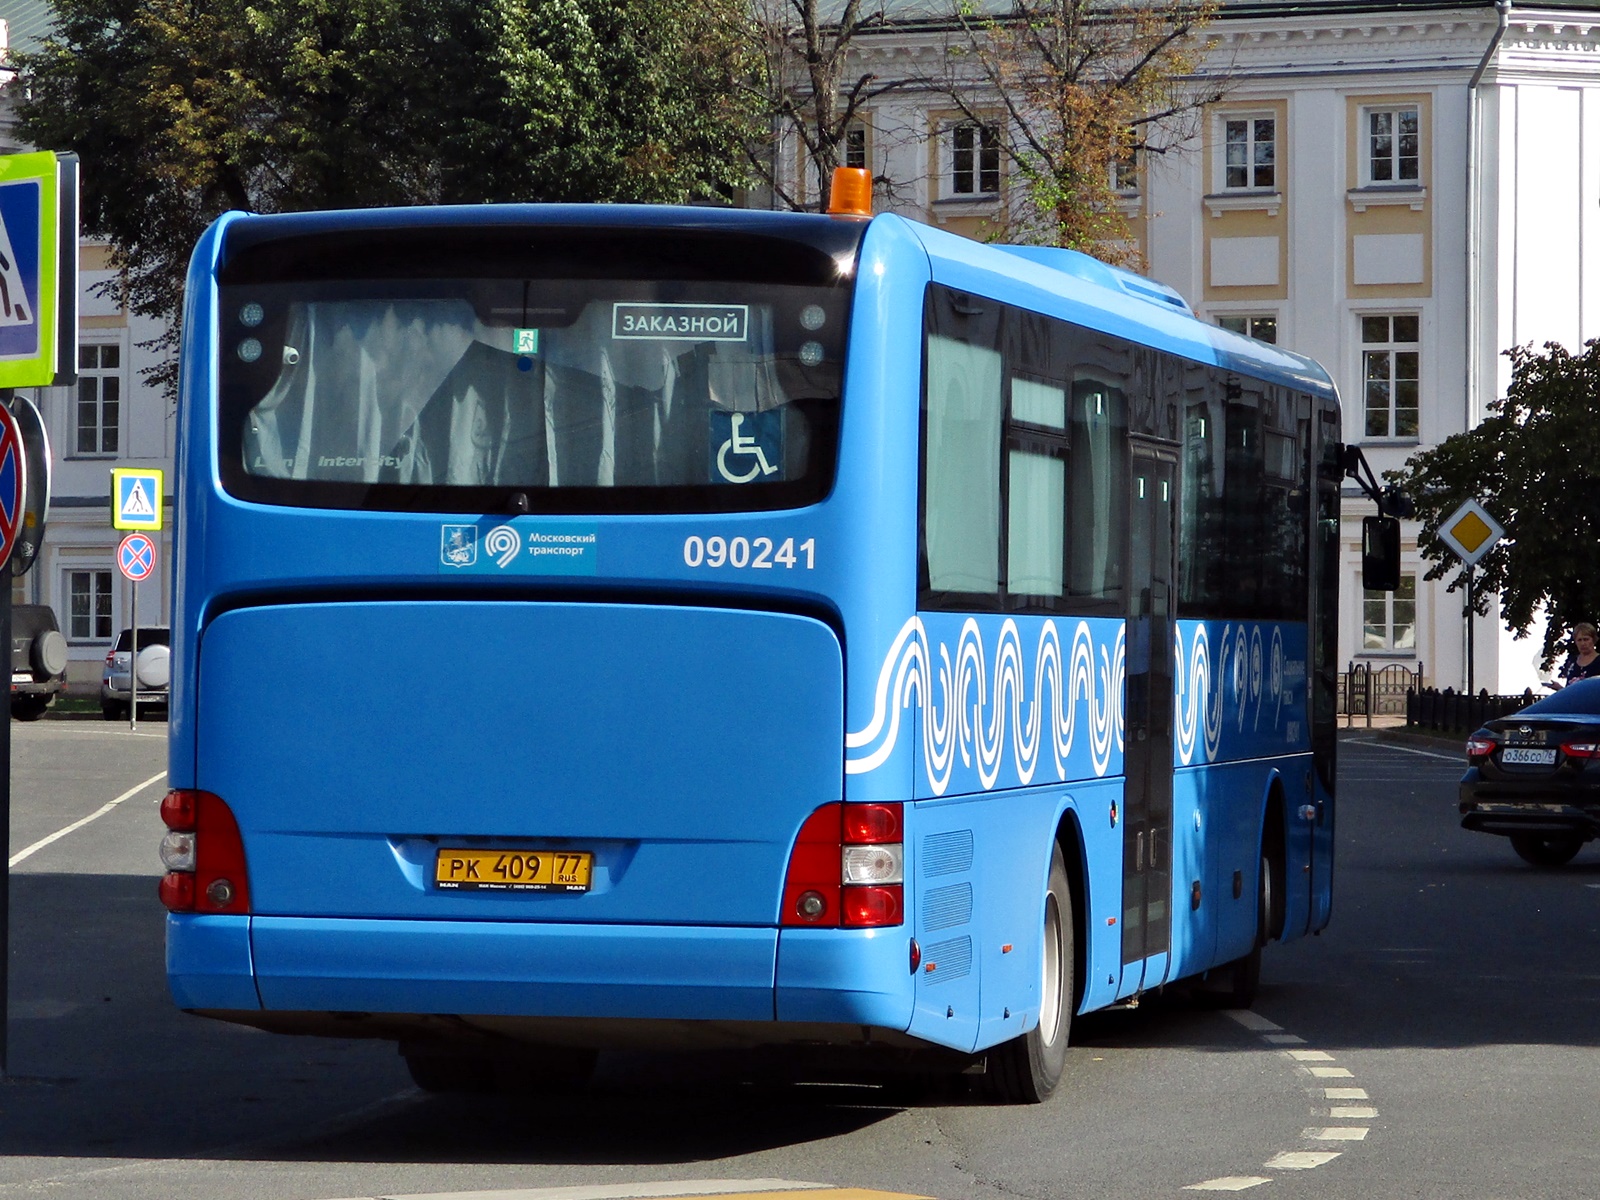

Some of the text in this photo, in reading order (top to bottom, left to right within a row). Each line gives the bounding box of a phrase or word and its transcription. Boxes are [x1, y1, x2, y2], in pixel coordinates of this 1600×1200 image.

[622, 313, 738, 333] ЗАКАЗНОЙ
[318, 456, 402, 469] Interity
[529, 533, 596, 543] Московский
[529, 547, 584, 556] транспорт
[683, 535, 815, 569] 090241
[492, 855, 541, 880] 409
[557, 855, 582, 874] 77
[558, 874, 578, 882] RUS
